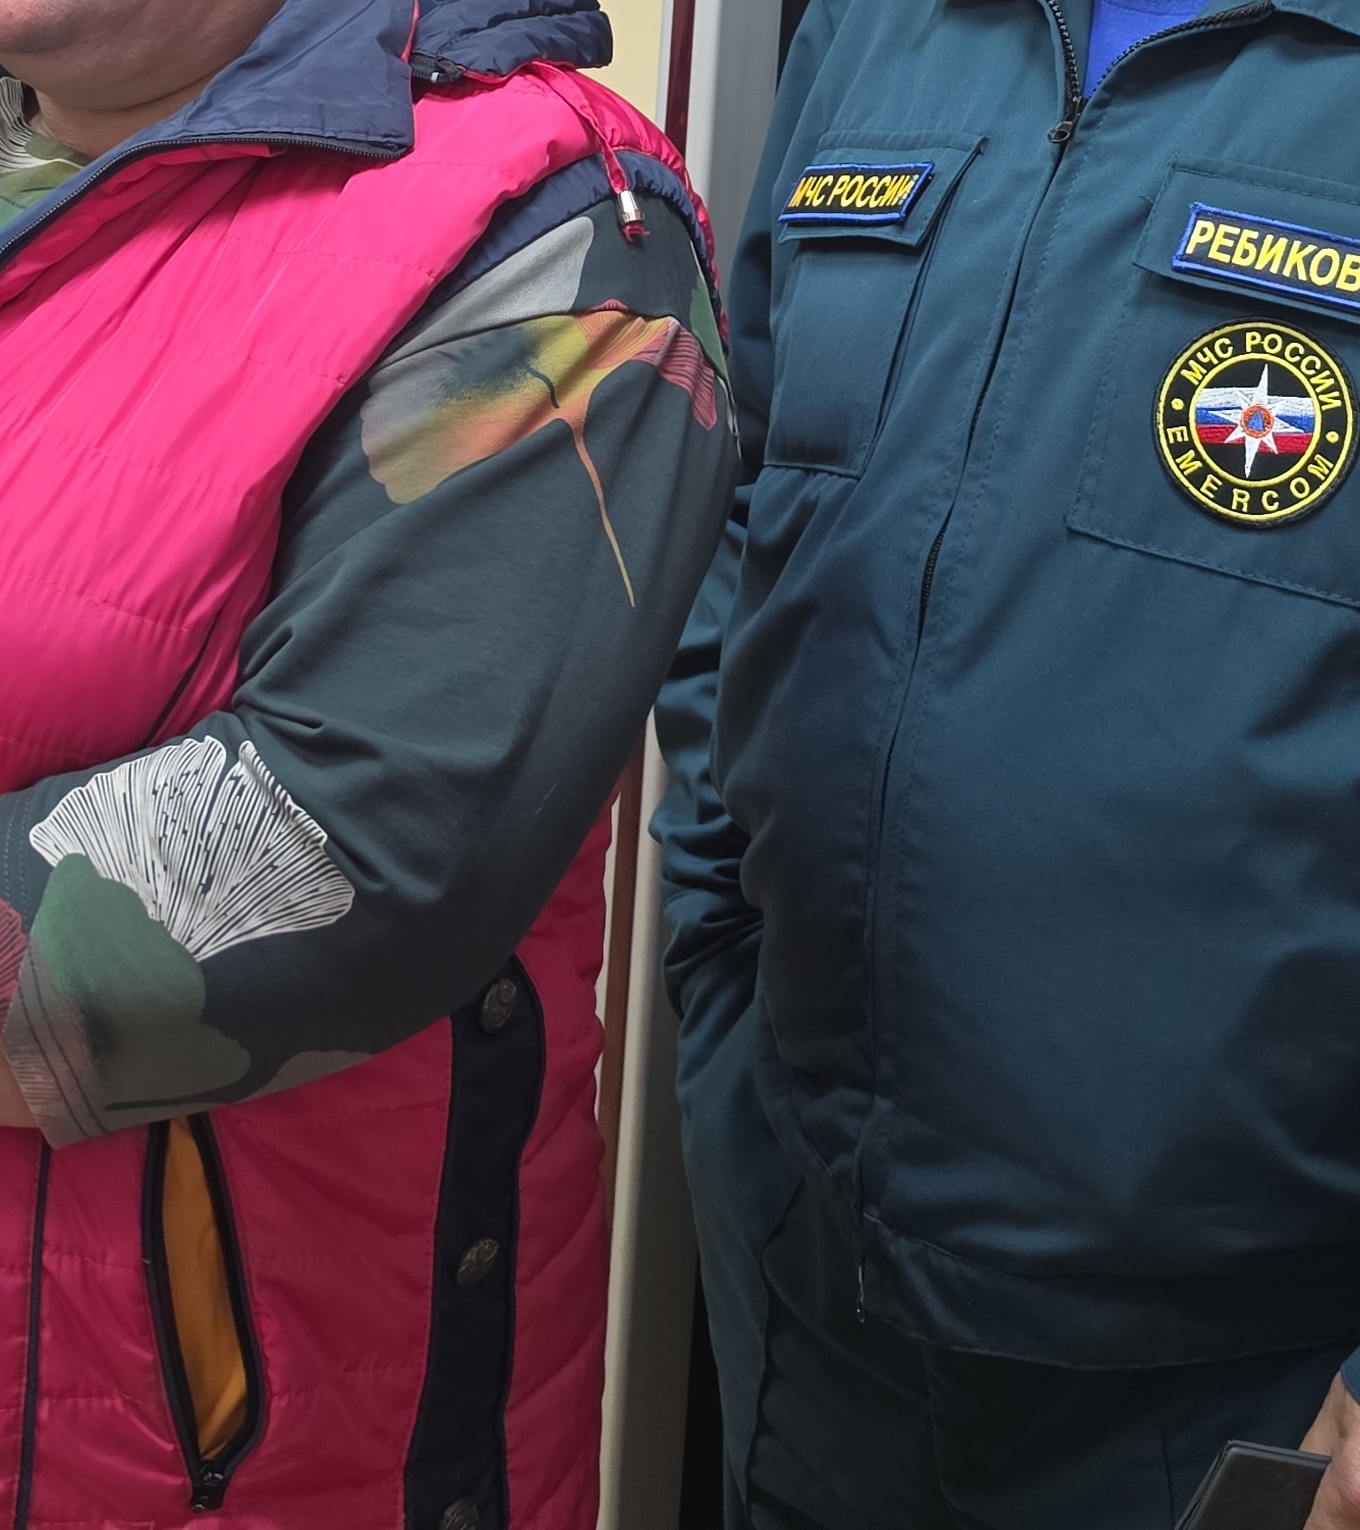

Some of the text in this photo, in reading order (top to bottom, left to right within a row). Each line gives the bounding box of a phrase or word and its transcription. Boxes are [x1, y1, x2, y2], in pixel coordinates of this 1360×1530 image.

[788, 174, 919, 208] МЧС РОССИИ
[1181, 331, 1342, 411] МЧС РОССИИ
[1167, 425, 1334, 513] EMERCOM
